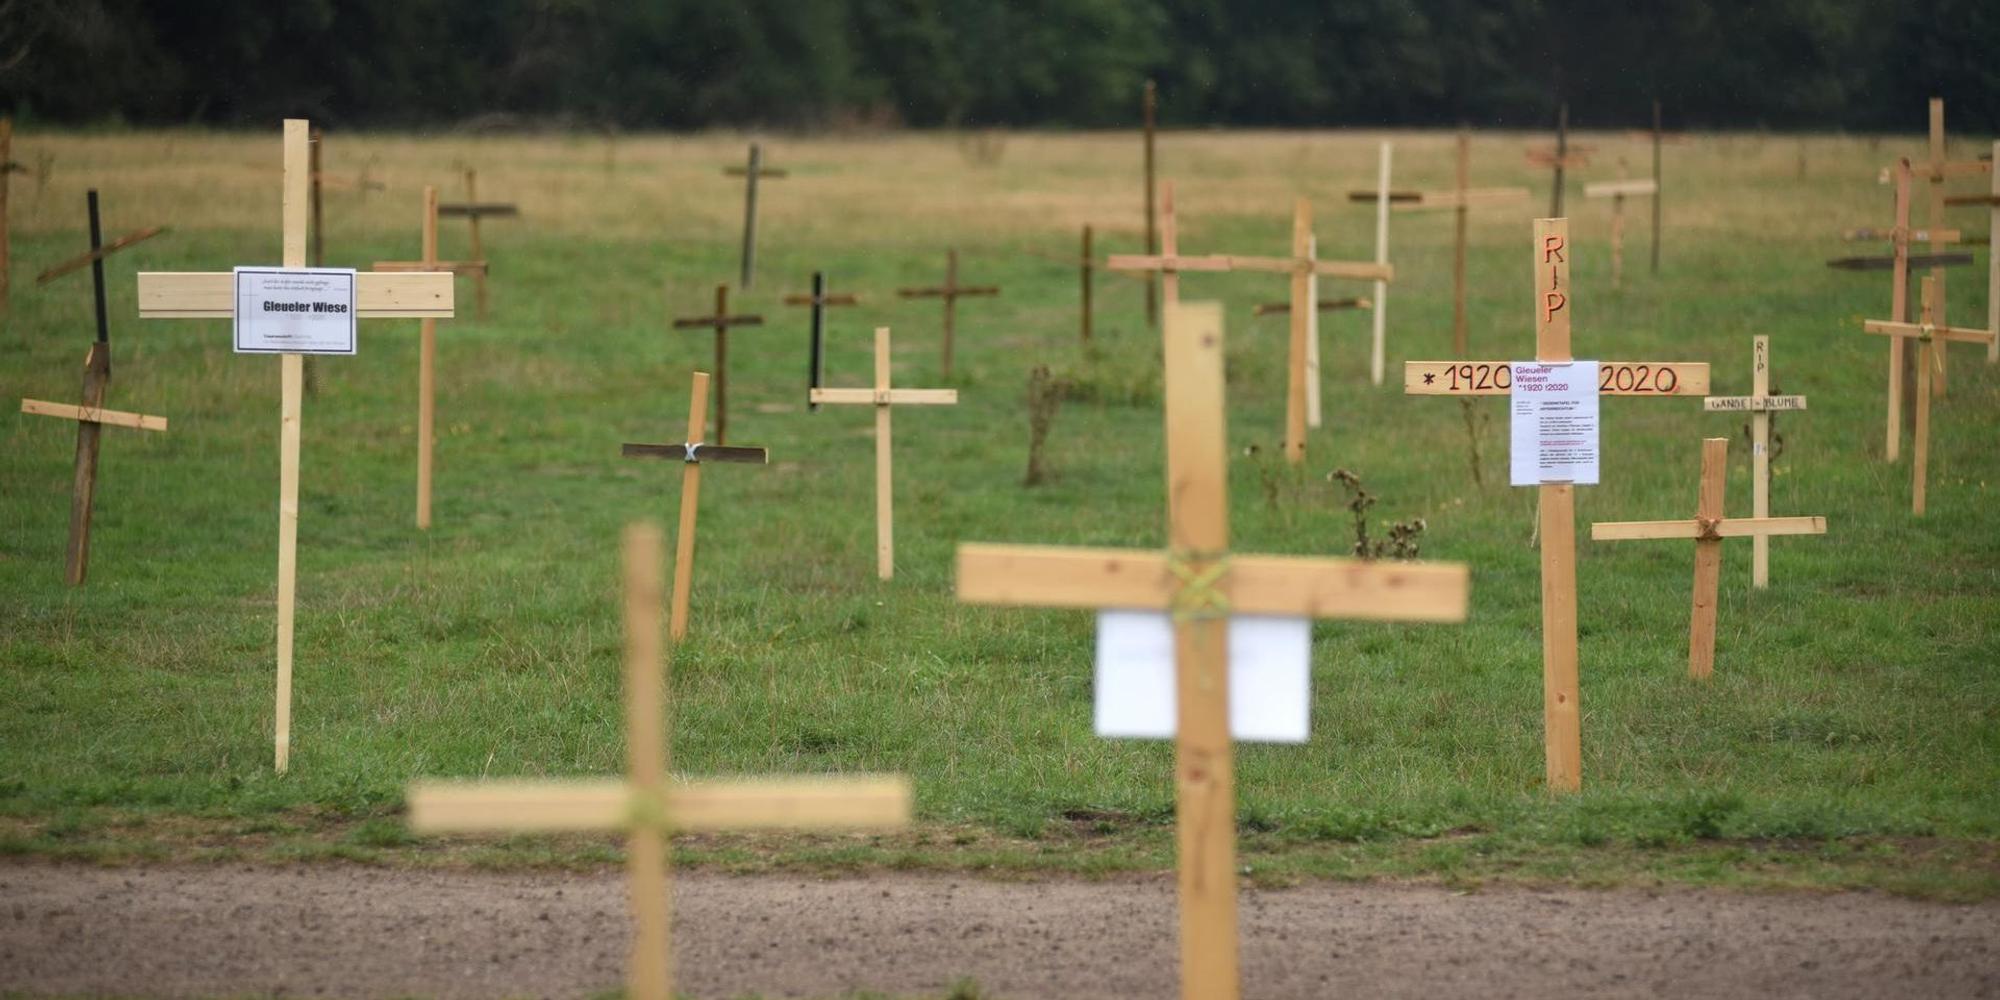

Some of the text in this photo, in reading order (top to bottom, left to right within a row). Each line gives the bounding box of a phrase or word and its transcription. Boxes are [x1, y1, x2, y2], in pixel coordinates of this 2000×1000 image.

[1544, 235, 1566, 323] RIP
[263, 300, 348, 314] Gleueler Wiese
[1515, 366, 1552, 375] Gleueler
[1443, 364, 1513, 391] 1920
[1599, 365, 1678, 393] 2020
[1515, 375, 1549, 383] Wiesen
